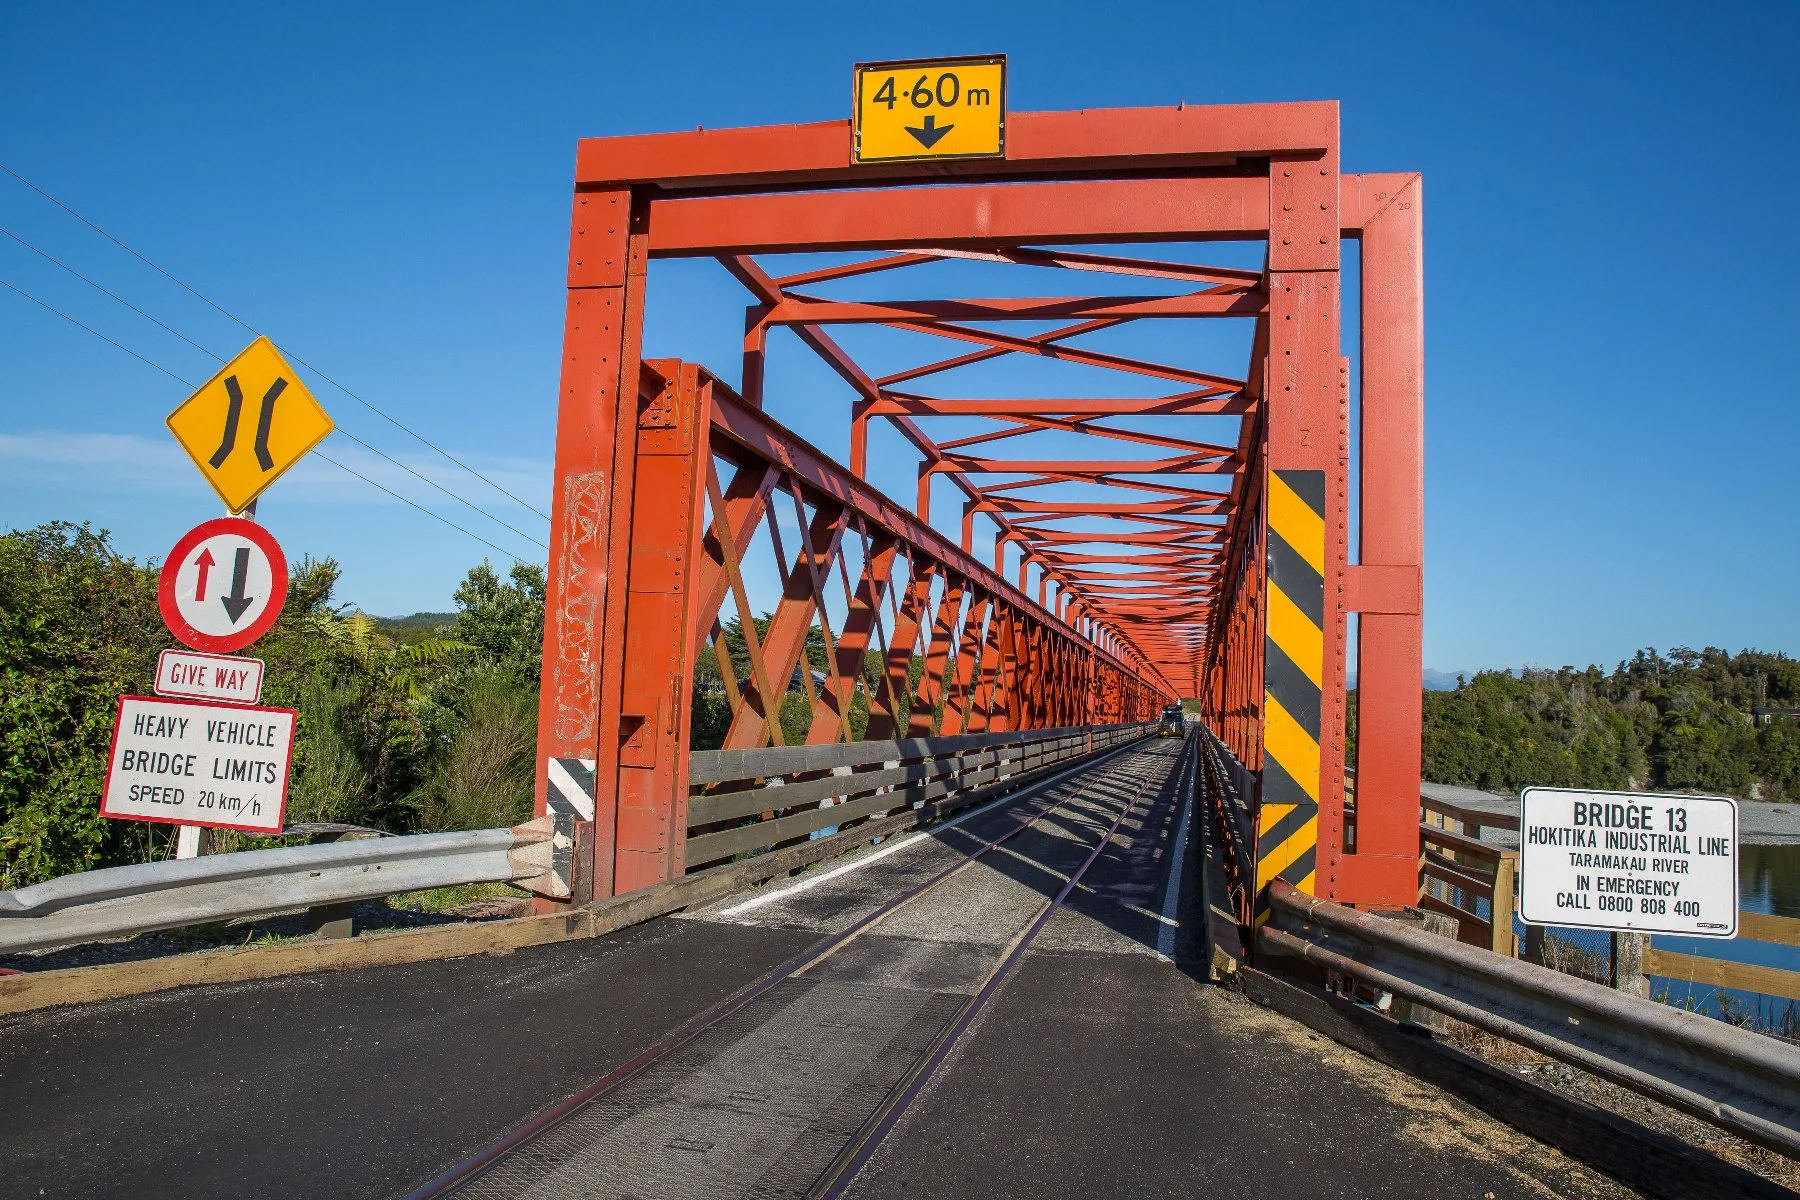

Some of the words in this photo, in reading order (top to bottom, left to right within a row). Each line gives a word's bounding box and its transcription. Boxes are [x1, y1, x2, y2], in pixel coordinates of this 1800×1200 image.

[967, 88, 990, 106] m
[1397, 202, 1411, 211] 20
[171, 663, 207, 687] GIVE
[215, 668, 248, 690] WAY
[134, 714, 189, 739] HEAVY
[207, 720, 276, 747] VEHICLE
[122, 750, 196, 776] BRIDGE
[213, 758, 277, 784] LIMITS
[129, 785, 184, 805] SPEED
[198, 791, 214, 808] 20
[219, 793, 261, 817] km/h
[1574, 802, 1653, 830] BRIDGE
[1666, 808, 1687, 832] 13
[1529, 826, 1596, 848] HOKITIKA
[1605, 831, 1690, 854] INDUSTRIAL
[1699, 837, 1729, 856] LINE
[1569, 853, 1646, 871] TARAMAKAU
[1653, 859, 1688, 874] RIVER
[1577, 875, 1589, 890] IN
[1597, 877, 1680, 896] EMERGENCY
[1557, 893, 1590, 909] CALL
[1598, 896, 1633, 912] 0800
[1640, 900, 1666, 914] 808
[1674, 901, 1700, 917] 400
